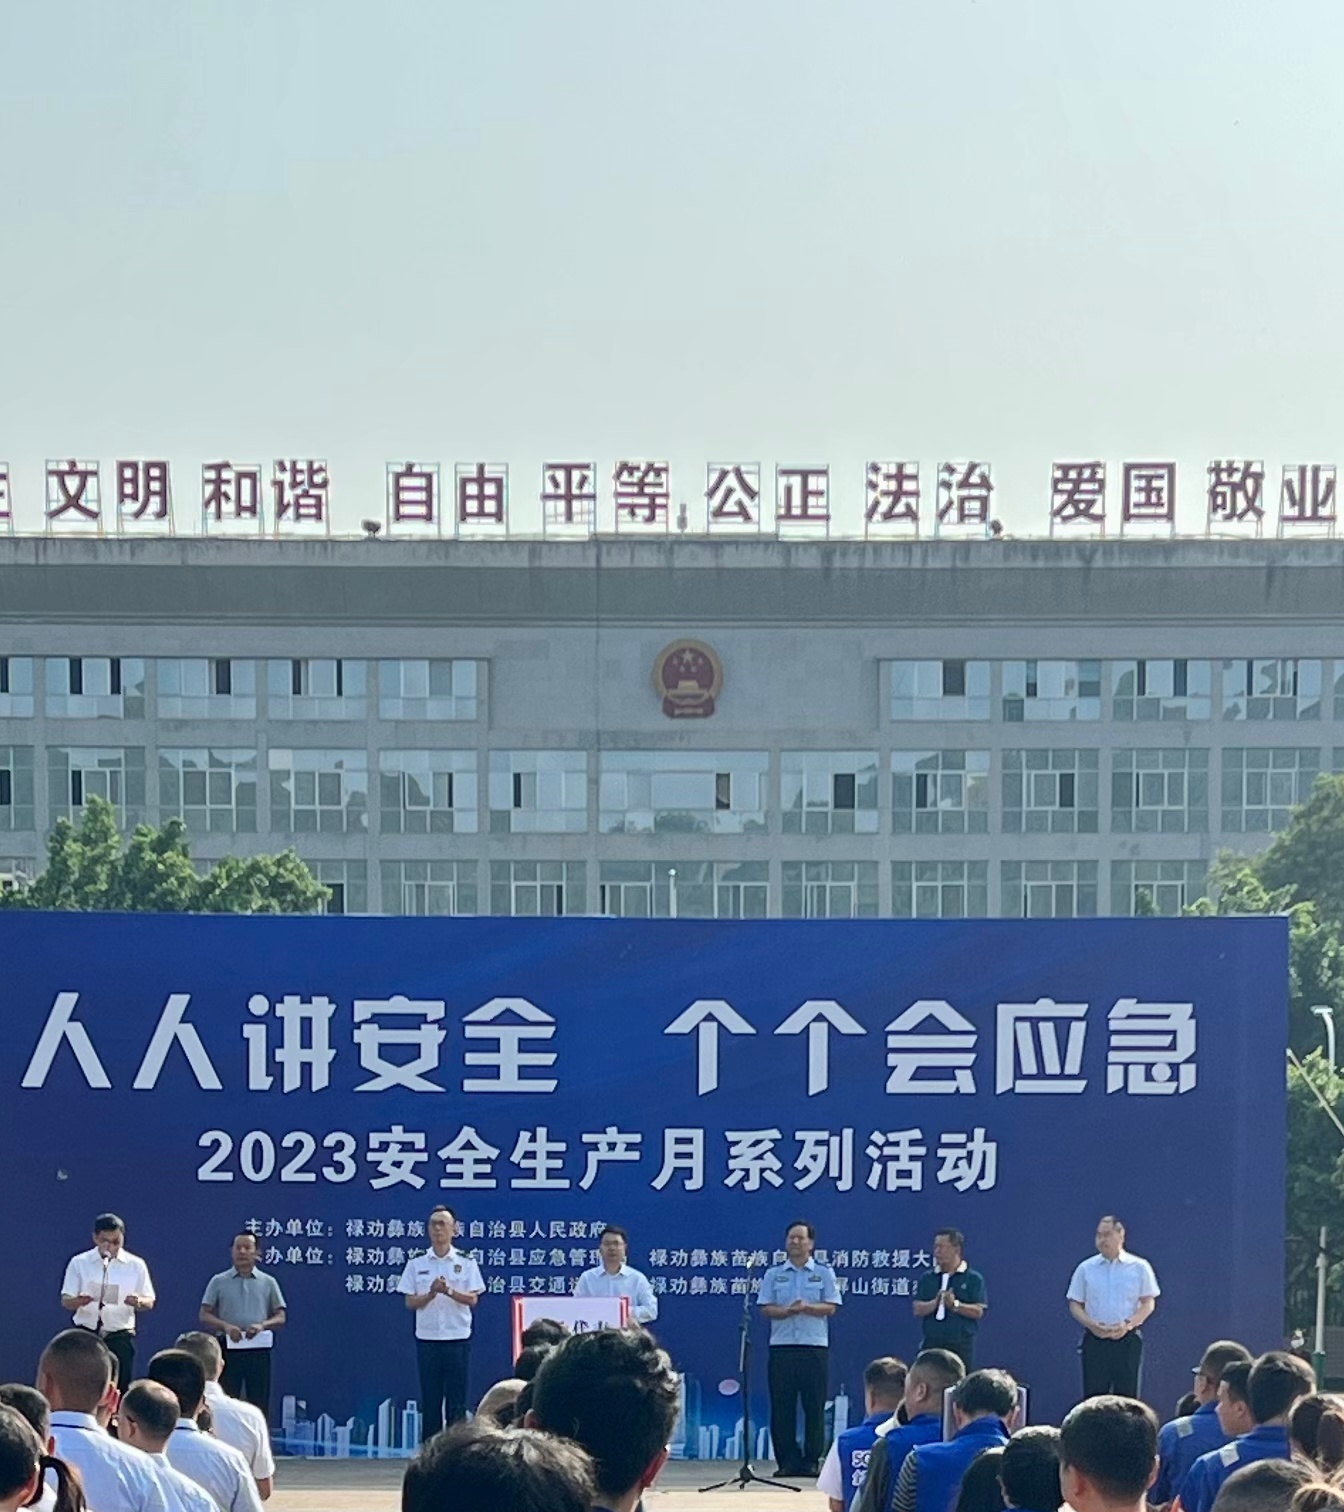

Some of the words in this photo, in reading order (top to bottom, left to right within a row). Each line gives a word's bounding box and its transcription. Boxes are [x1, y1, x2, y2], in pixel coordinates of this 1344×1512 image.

[44, 458, 170, 520] 文明
[202, 460, 330, 523] 和谐
[392, 461, 504, 524] 自由
[540, 461, 671, 524] 平等
[705, 464, 831, 523] 公正
[864, 461, 993, 524] 法治
[1050, 461, 1176, 524] 爱国
[1207, 460, 1338, 524] 敬业
[20, 991, 558, 1094] 人人讲安全
[663, 997, 1197, 1097] 个个会应急
[197, 1126, 998, 1192] 2023安全生产月系列活动
